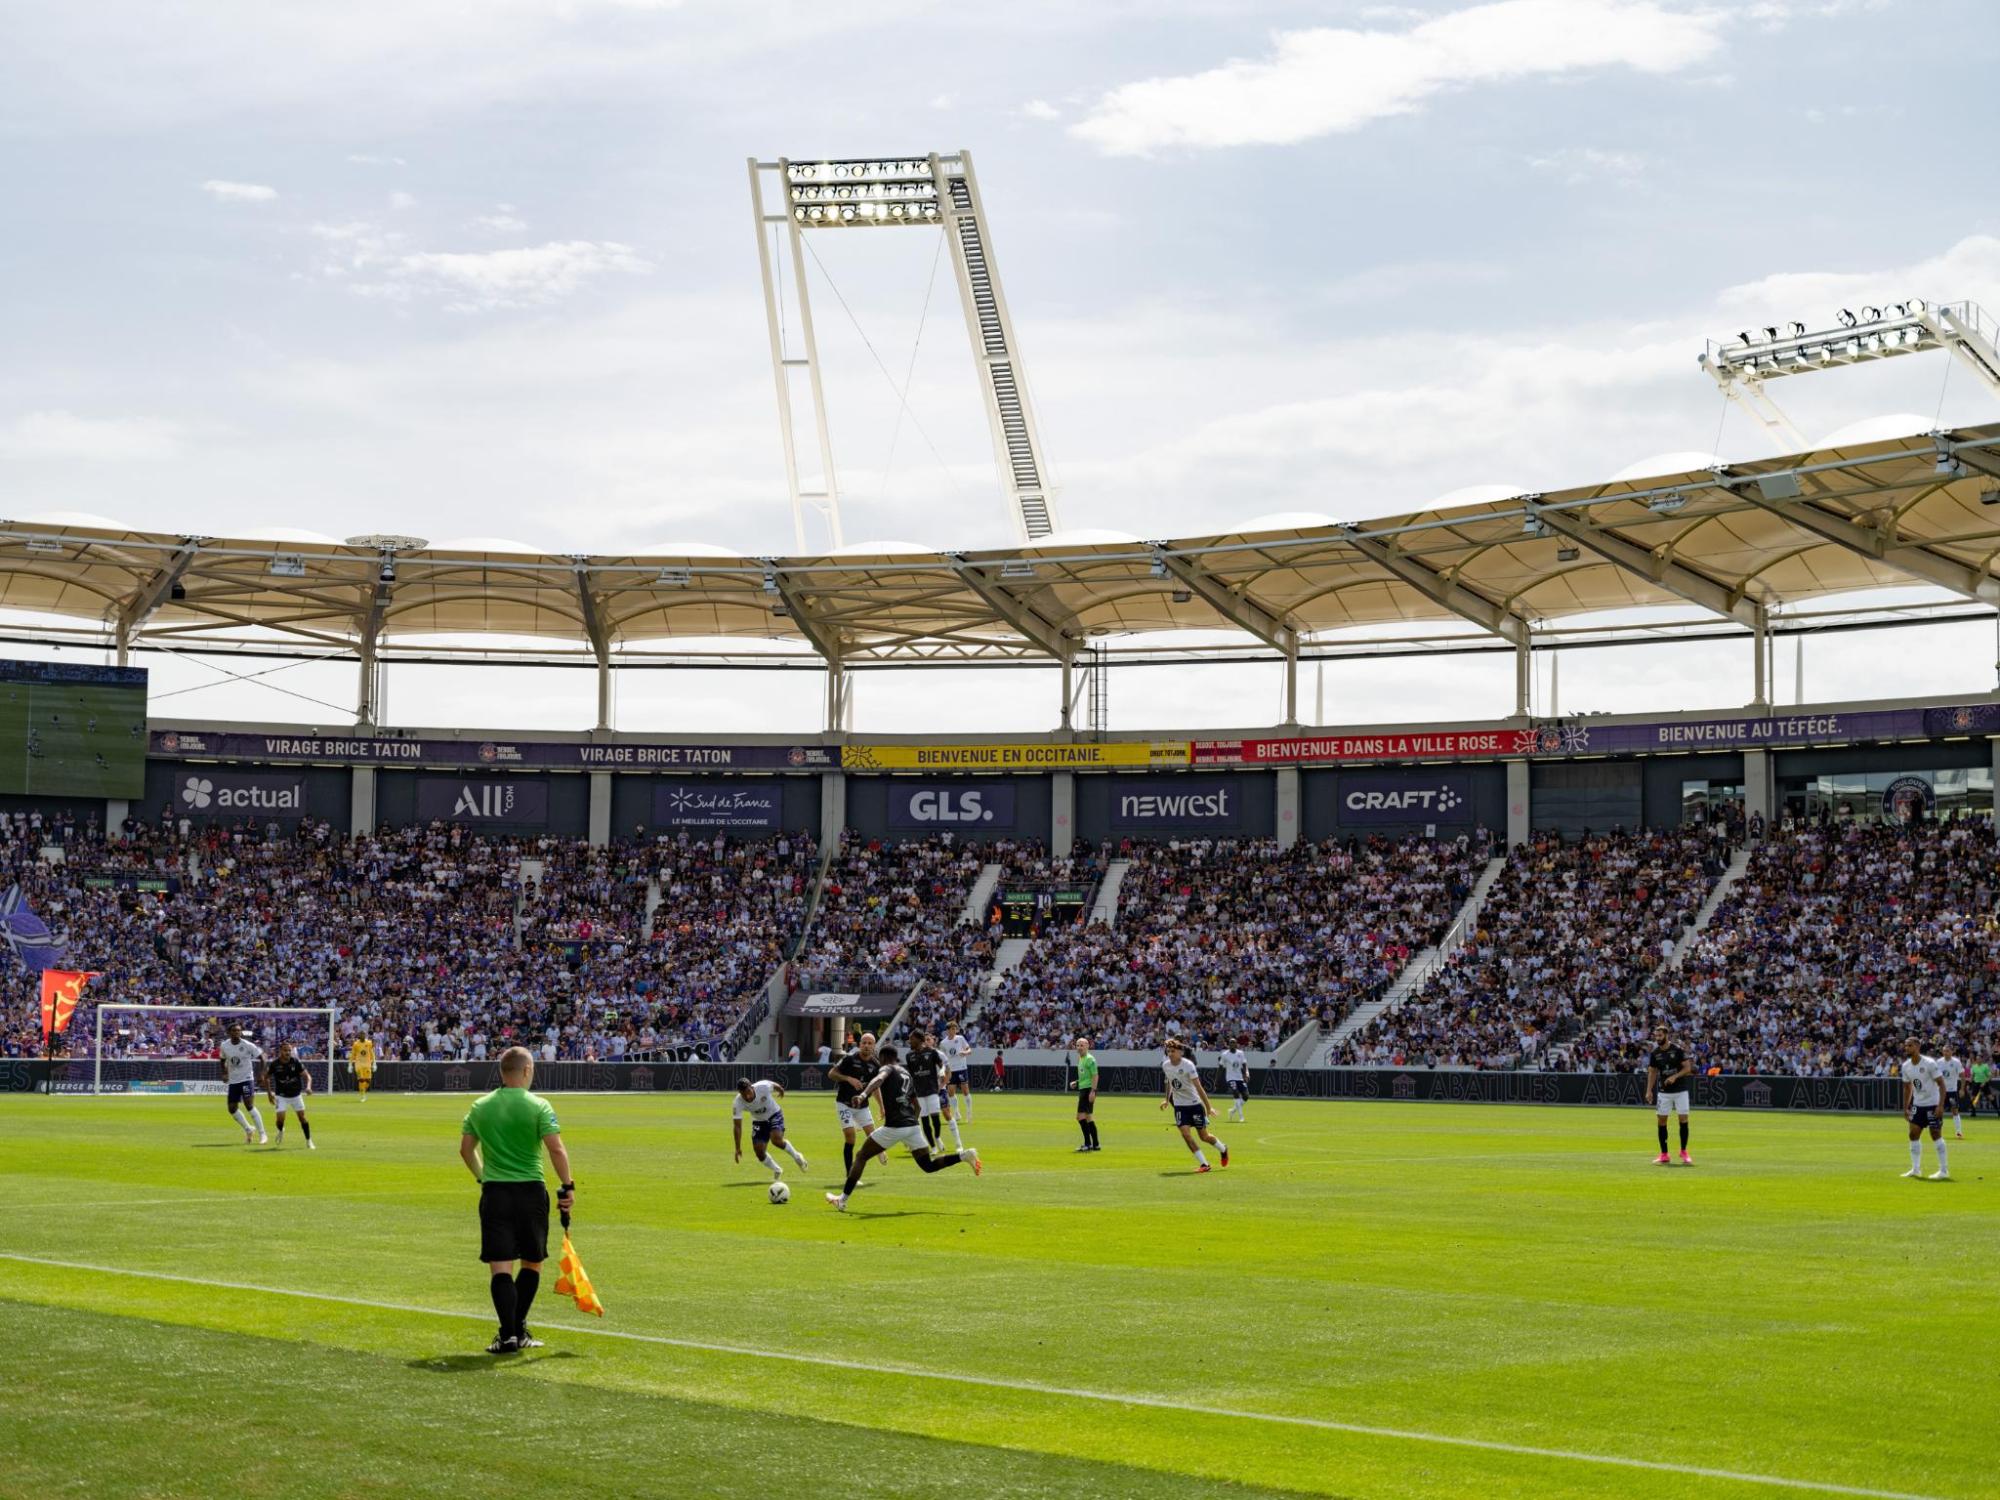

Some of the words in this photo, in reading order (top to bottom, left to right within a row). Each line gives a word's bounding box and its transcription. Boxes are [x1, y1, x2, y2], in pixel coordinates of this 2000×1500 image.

[1659, 723, 1748, 742] BIENVENUE
[1752, 722, 1773, 738] AU
[1776, 714, 1842, 738] TÉFÉCÉ.
[266, 739, 322, 755] VIRAGE
[325, 741, 369, 757] BRICE
[372, 743, 421, 758] TATON
[580, 747, 635, 762] VIRAGE
[637, 748, 681, 763] BRICE
[684, 749, 732, 764] TATON
[917, 748, 1000, 763] BIENVENUE
[1003, 748, 1021, 762] EN
[1025, 747, 1106, 762] OCCITANIE.
[1256, 740, 1339, 758] BIENVENUE
[1344, 739, 1384, 755] DANS
[1388, 738, 1408, 754] LA
[1412, 736, 1455, 752] VILLE
[1459, 735, 1503, 750] ROSE.
[217, 785, 300, 809] actual
[693, 793, 718, 810] Sud
[718, 796, 732, 809] de
[732, 792, 773, 810] France
[1121, 788, 1229, 818] newrest
[1346, 790, 1437, 810] CRAFT
[55, 1082, 84, 1091] SERGE
[87, 1082, 124, 1091] BANCO
[1262, 1070, 1380, 1097] ABATILLES
[1429, 1072, 1560, 1102] ABATILLES
